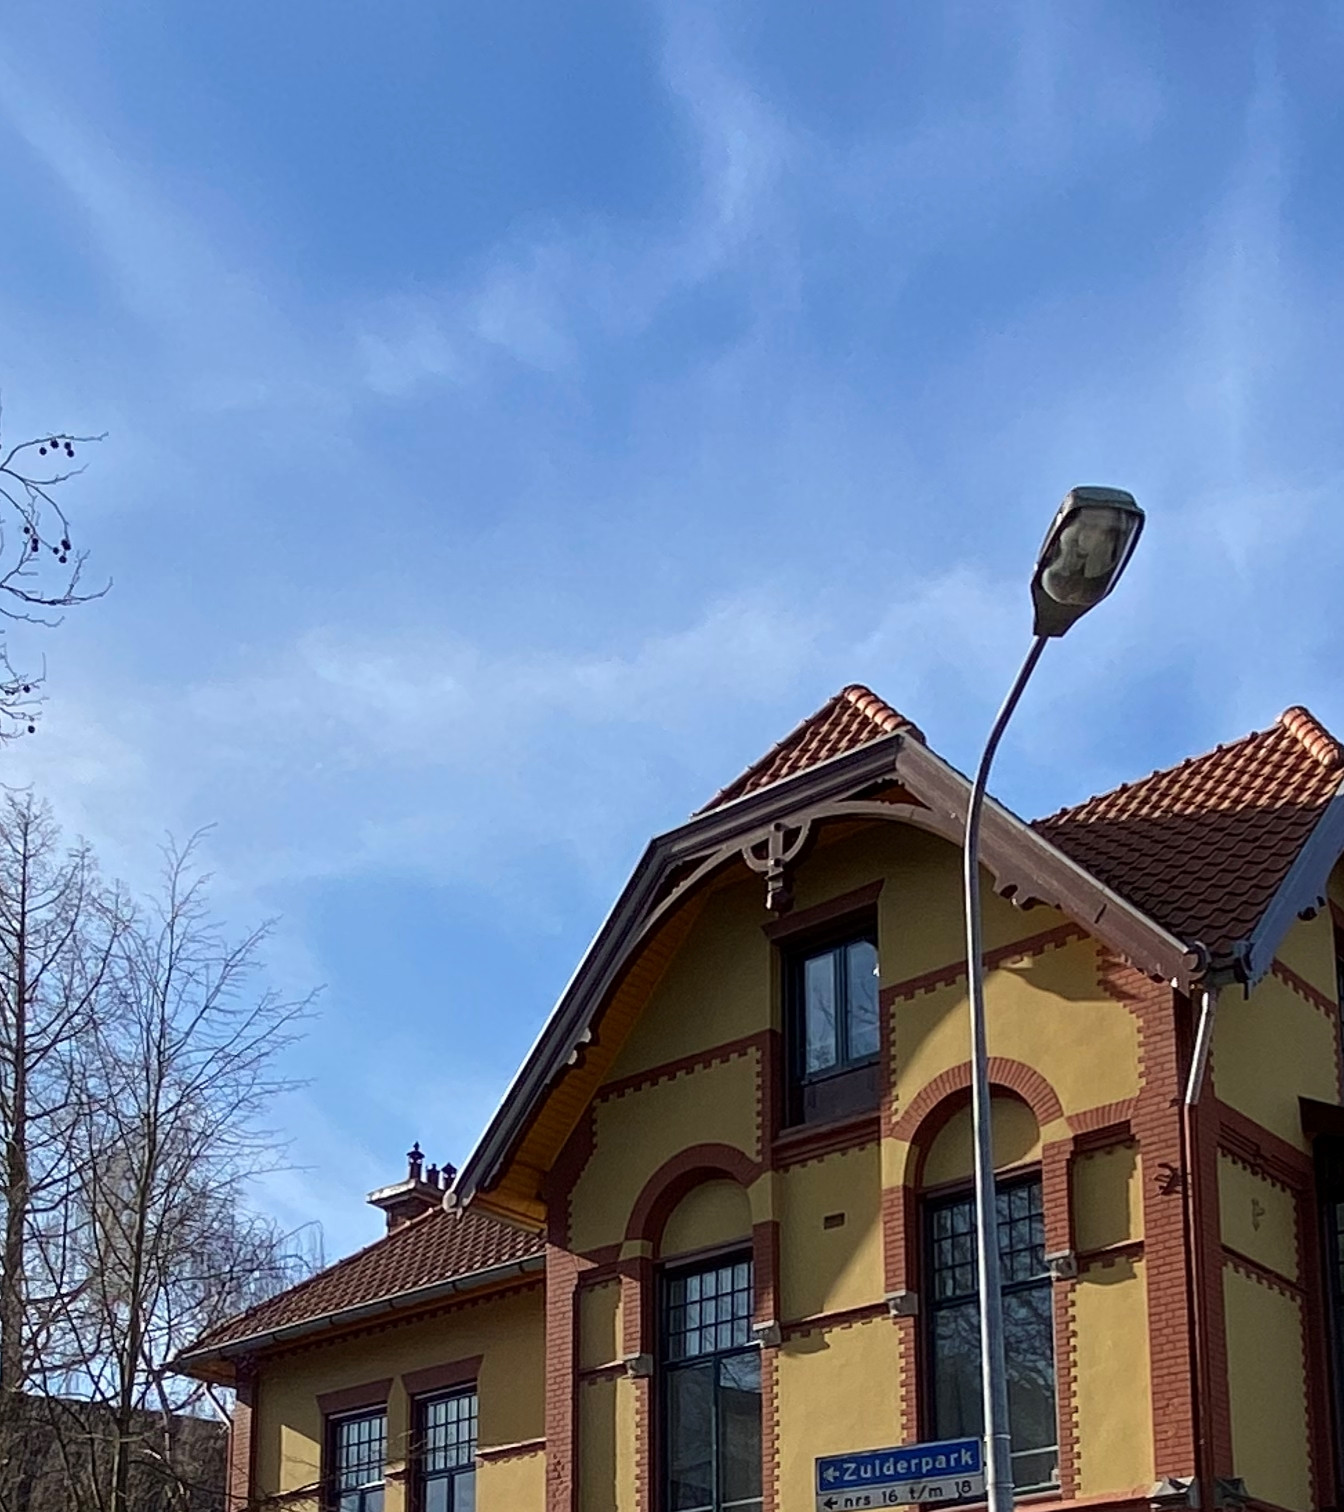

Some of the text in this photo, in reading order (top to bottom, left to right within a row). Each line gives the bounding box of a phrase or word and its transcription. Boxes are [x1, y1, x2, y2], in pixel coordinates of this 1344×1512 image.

[842, 1449, 973, 1481] Zuiderpark
[844, 1480, 972, 1508] nrs 16 t/m 18
